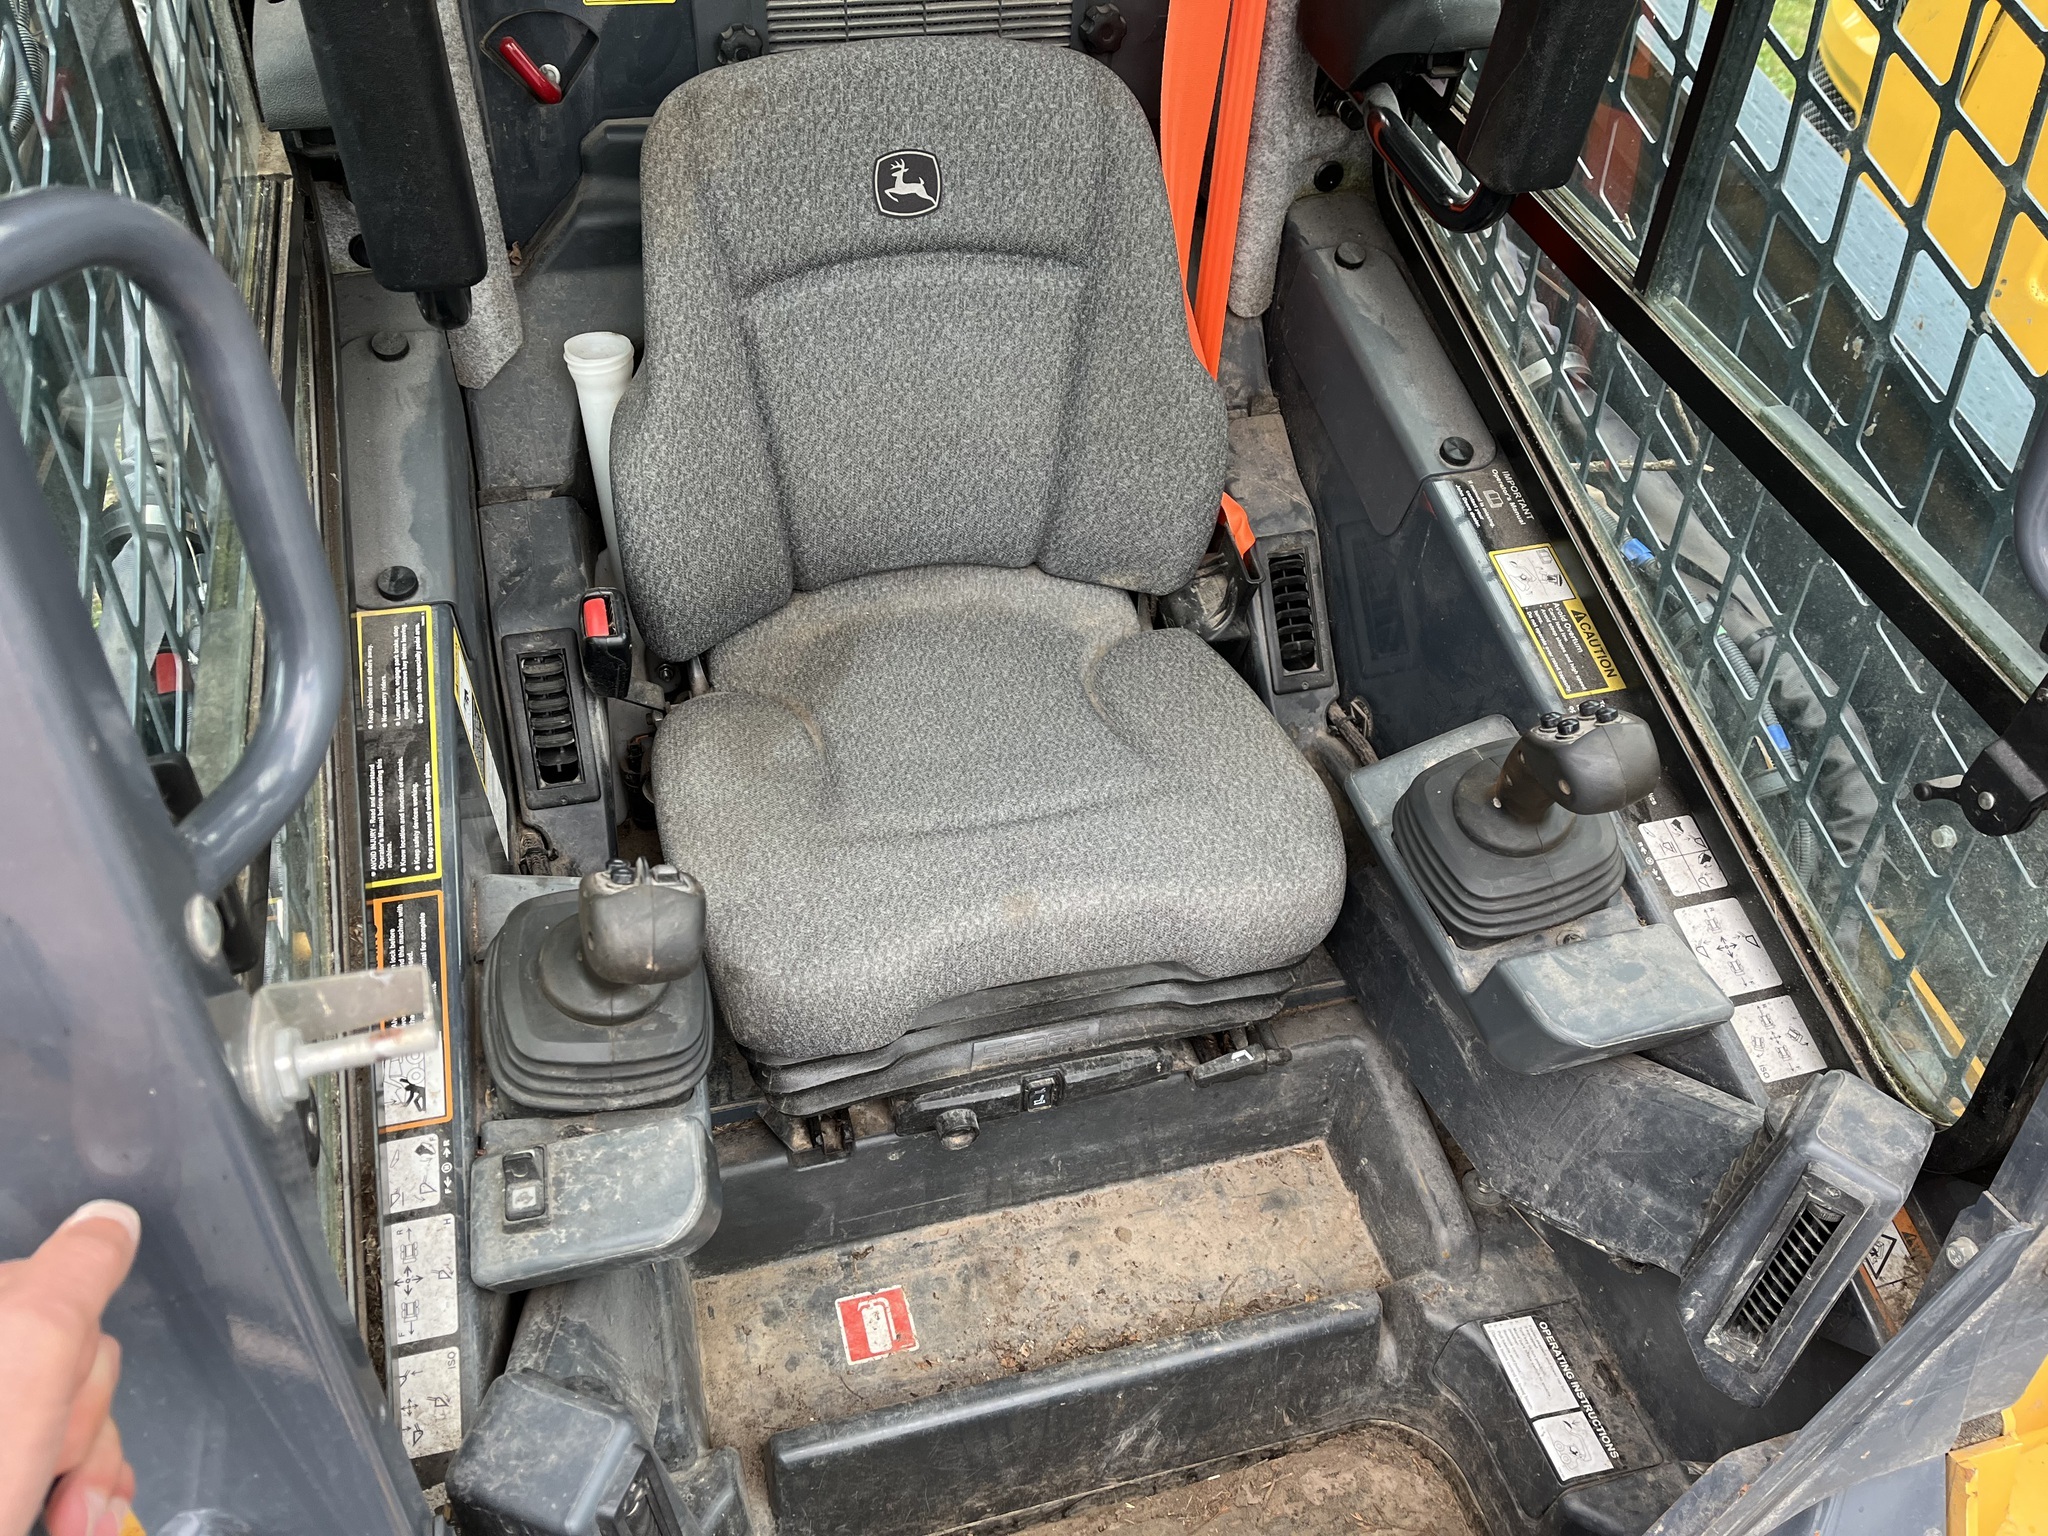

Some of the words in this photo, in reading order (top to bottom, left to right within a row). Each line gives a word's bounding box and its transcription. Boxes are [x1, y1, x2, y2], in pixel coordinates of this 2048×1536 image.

[1455, 484, 1464, 496] John
[1462, 497, 1472, 511] Deere
[1492, 469, 1511, 501] Operator's
[1509, 502, 1526, 525] Manual
[1502, 471, 1534, 519] IMPORTANT
[1548, 608, 1557, 621] Carry
[1552, 600, 1568, 622] Avoid
[1564, 622, 1583, 653] Overturn
[414, 636, 422, 650] pedal
[1540, 609, 1551, 623] Avoid
[1564, 653, 1573, 663] and
[1570, 663, 1578, 674] high
[1576, 675, 1587, 690] speed
[1580, 622, 1617, 677] CAUTION
[411, 782, 419, 806] working.
[378, 838, 386, 869] Operator's
[419, 912, 427, 941] complete
[1759, 1064, 1770, 1079] ISO
[447, 1351, 456, 1369] ISO
[1539, 1322, 1574, 1379] OPERATING
[1571, 1382, 1619, 1458] INSTRUCTIONS
